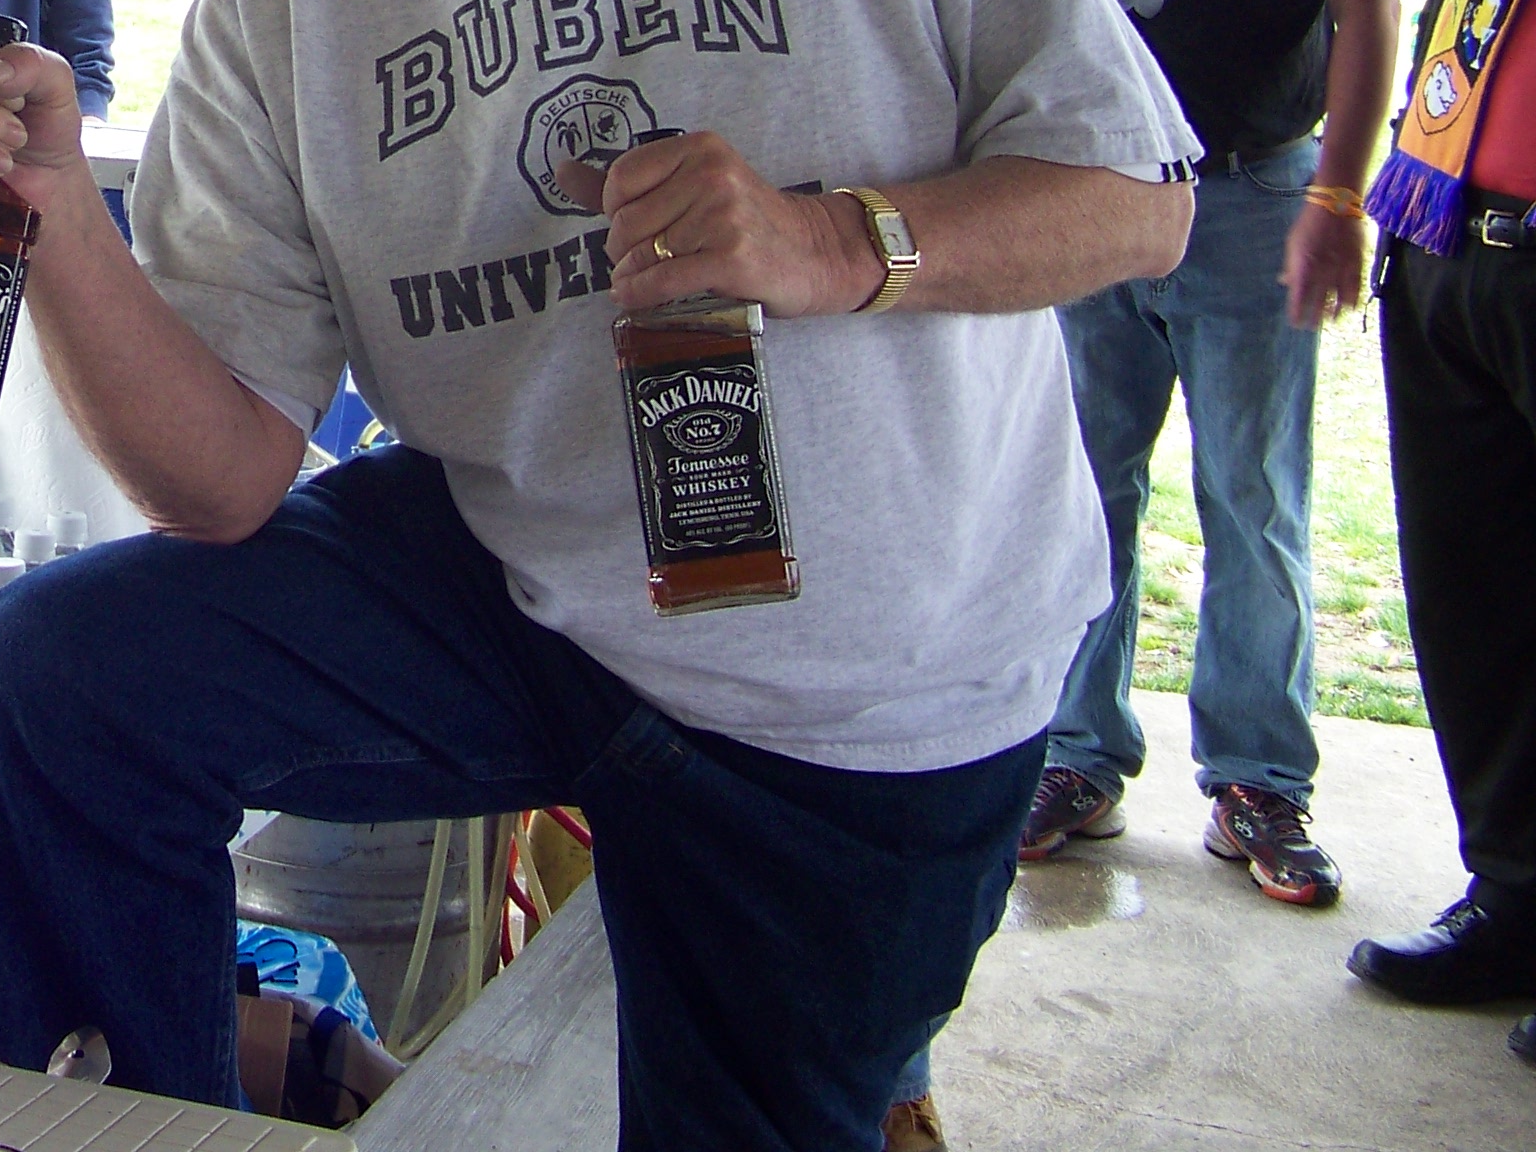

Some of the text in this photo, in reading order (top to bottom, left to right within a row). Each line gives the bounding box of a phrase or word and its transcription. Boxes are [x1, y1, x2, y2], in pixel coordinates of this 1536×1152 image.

[539, 88, 630, 128] DEUTSCHE
[637, 375, 763, 428] JACK DANIEL'S
[685, 423, 722, 440] No.7
[693, 417, 711, 427] Old
[667, 453, 750, 475] Tennessee
[672, 475, 752, 498] WHISKEY
[669, 510, 689, 519] JACK
